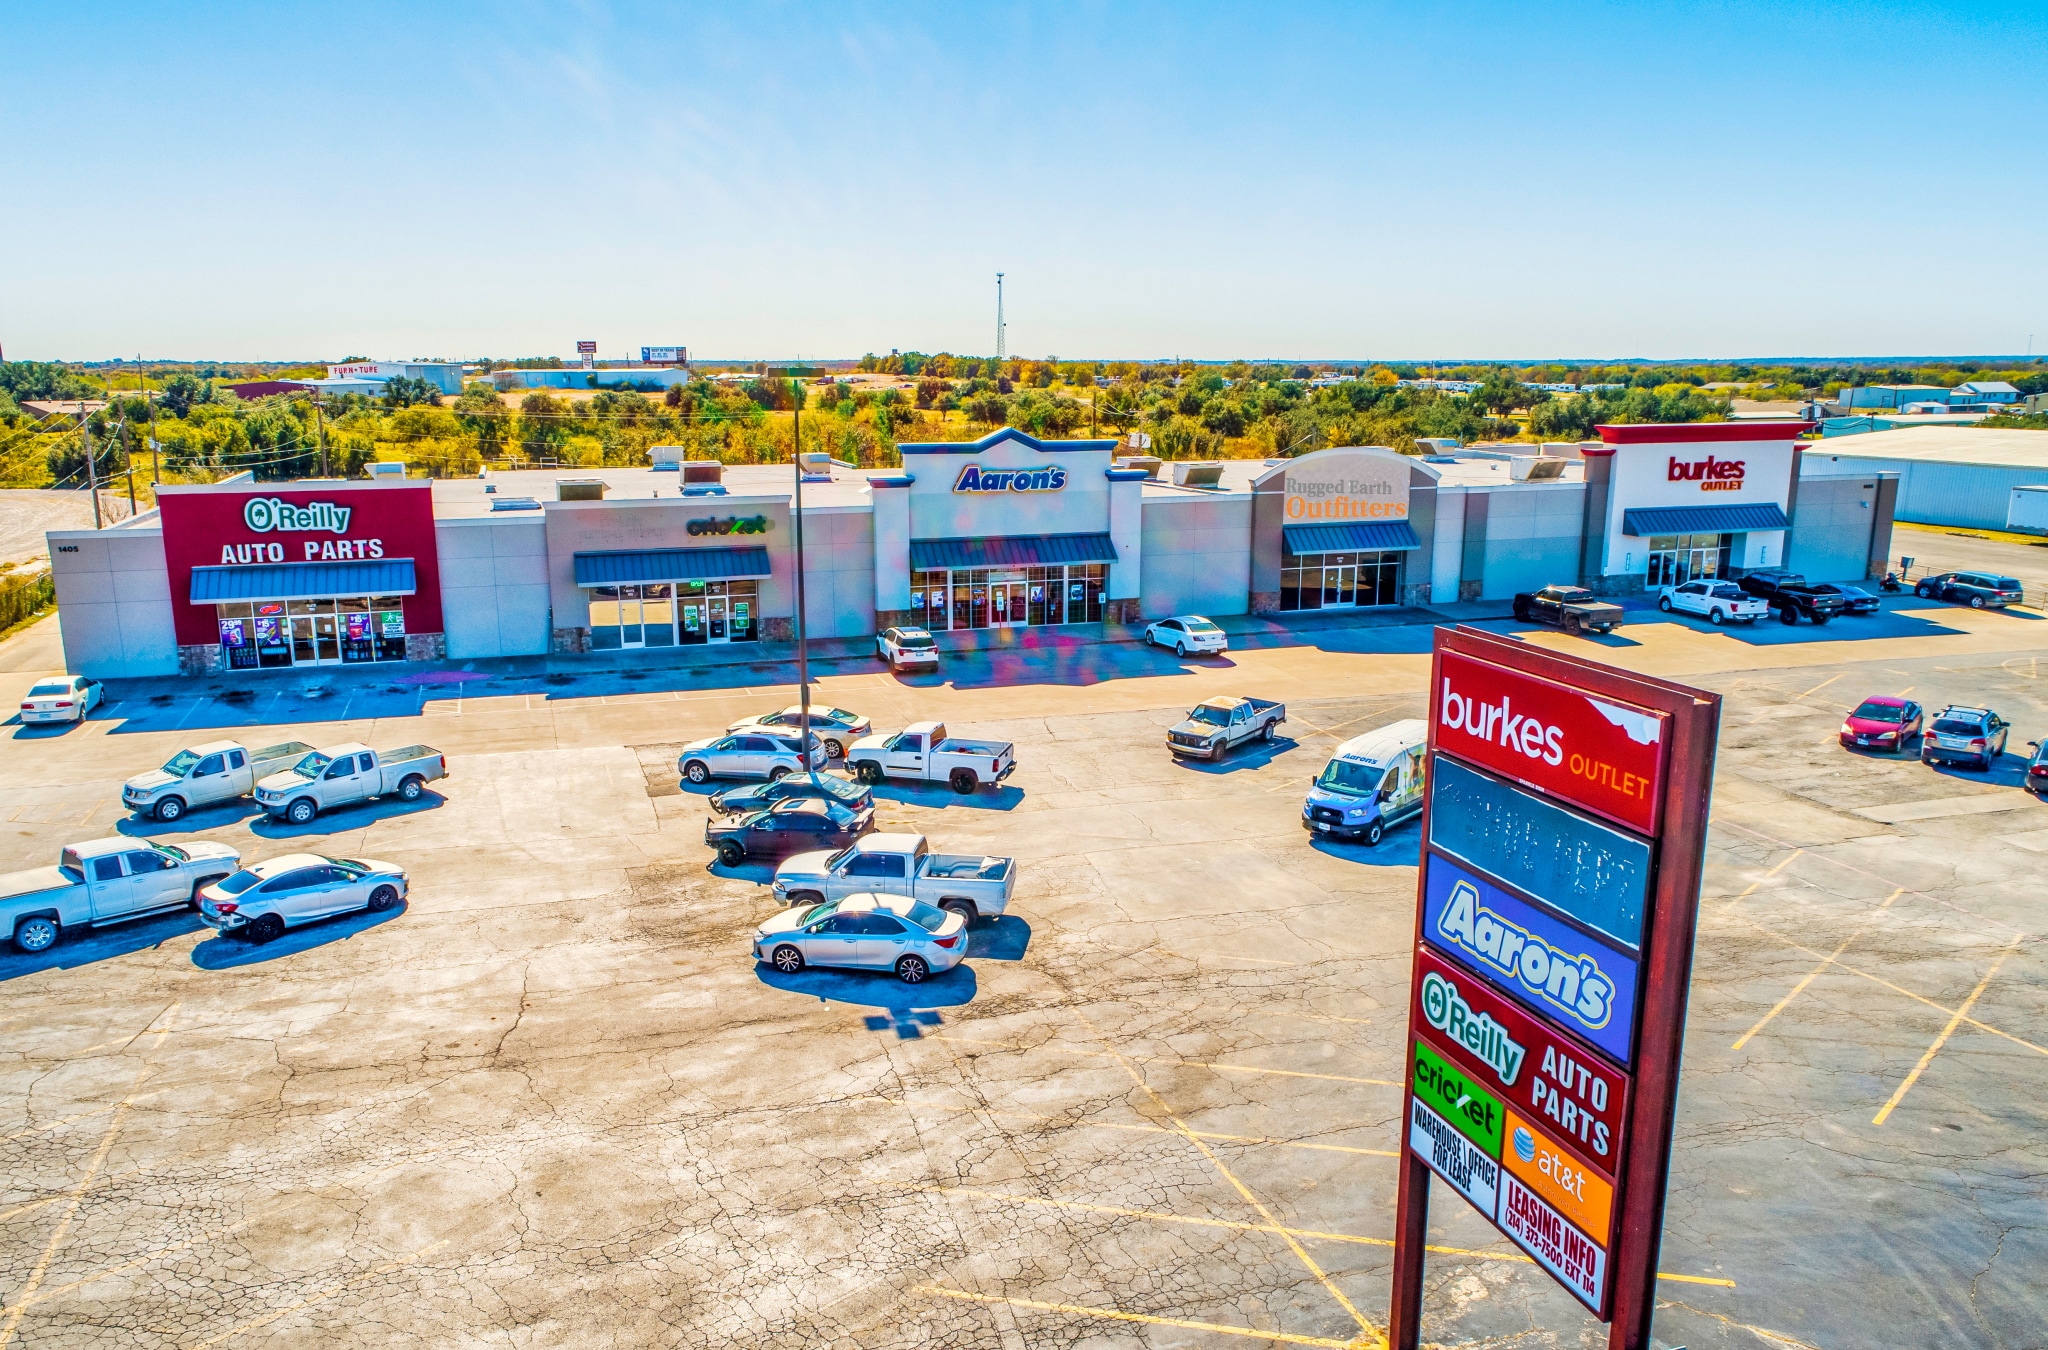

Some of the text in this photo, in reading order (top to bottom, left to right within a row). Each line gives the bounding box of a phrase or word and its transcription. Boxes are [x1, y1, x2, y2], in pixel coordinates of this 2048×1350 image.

[955, 465, 1067, 493] Aaron's
[1286, 478, 1393, 498] Rugged Earth
[1668, 455, 1746, 481] burkes
[1701, 480, 1744, 491] OUTLET
[245, 498, 350, 533] O'Reilly
[1286, 496, 1407, 519] Outfitters
[221, 539, 384, 564] AUTO PARTS
[1441, 677, 1649, 800] burkes OUTLET
[1441, 887, 1610, 1021] Aaron's
[1423, 974, 1523, 1084] O'Reilly
[1416, 1058, 1494, 1136] cricket
[1541, 1045, 1608, 1112] AUTO
[1415, 1102, 1461, 1161] WAREHOUSE
[1468, 1147, 1496, 1190] OFFICE
[1532, 1076, 1610, 1156] PARTS
[1432, 1140, 1472, 1193] FOR LEASE
[1538, 1149, 1586, 1203] at&t
[1505, 1206, 1595, 1297] (214) 373-7500 EXT 114
[1508, 1179, 1596, 1277] LEASING INFO
